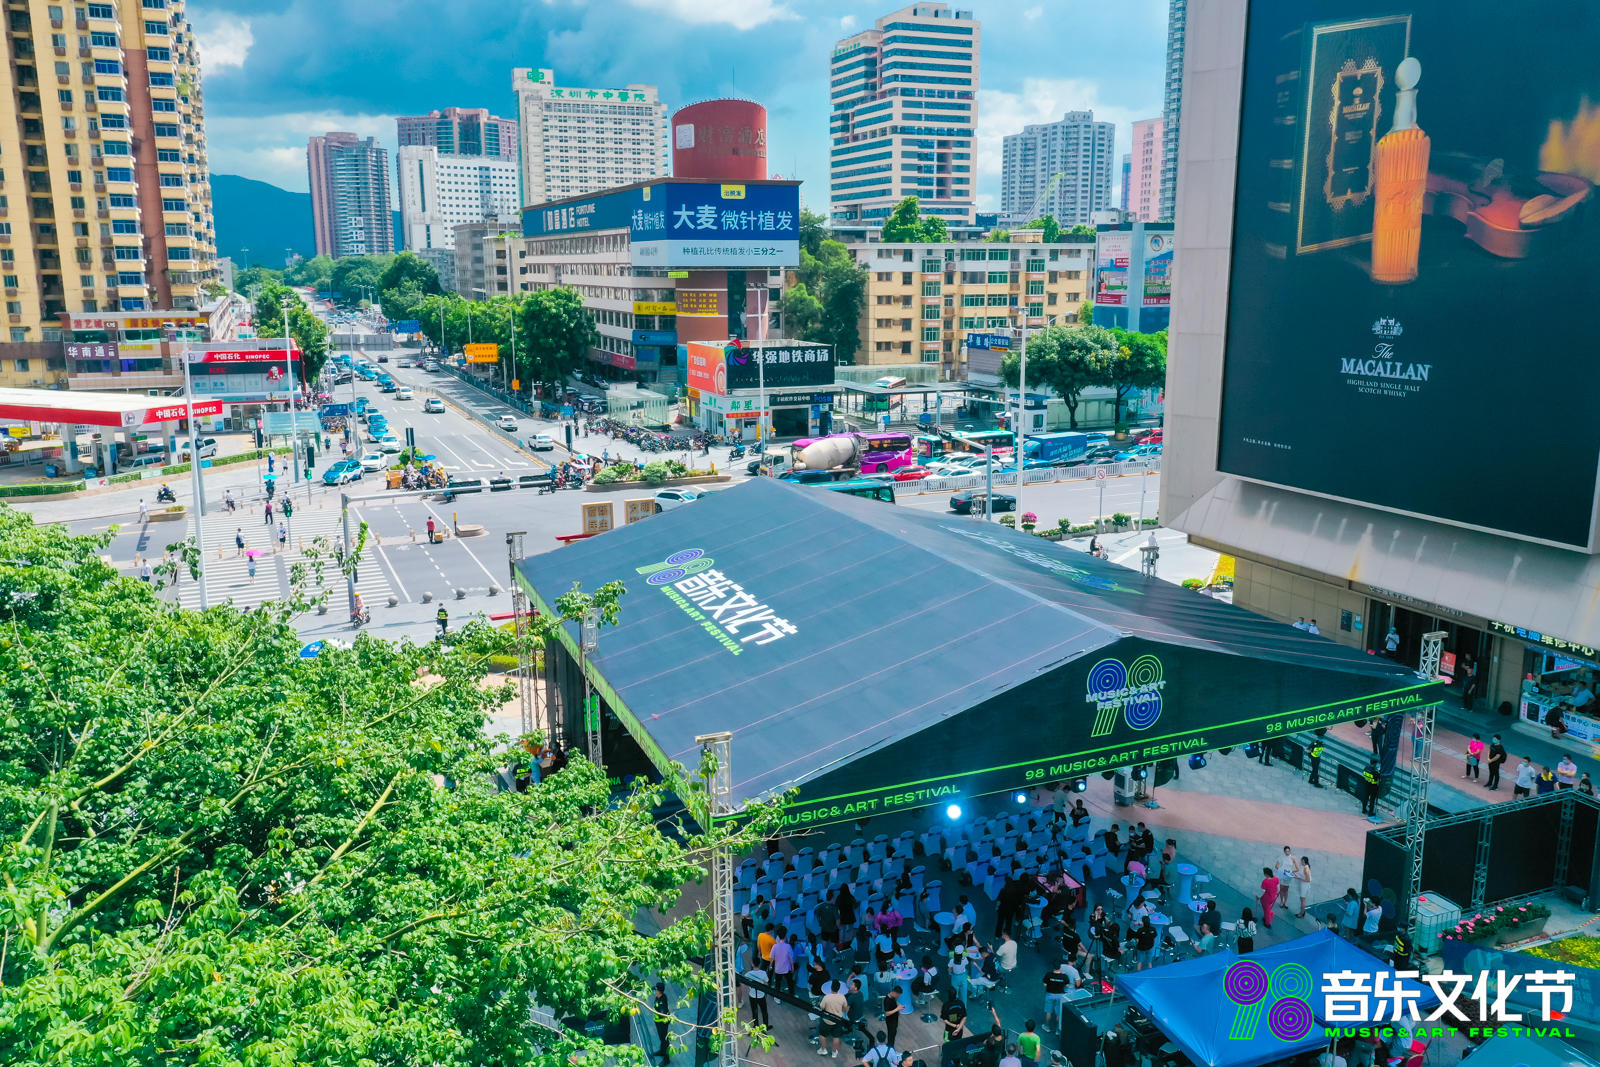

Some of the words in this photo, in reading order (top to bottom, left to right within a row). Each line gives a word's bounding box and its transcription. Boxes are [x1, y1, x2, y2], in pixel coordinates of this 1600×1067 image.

[631, 209, 644, 231] 大麦
[673, 203, 718, 230] 大麦
[720, 209, 793, 231] 微针植发
[67, 345, 105, 358] 华南通
[752, 349, 829, 365] 华强地铁商场
[1372, 342, 1394, 359] The
[1340, 357, 1432, 381] MACALLAN
[1346, 379, 1378, 388] HIGHLAND
[1380, 382, 1401, 390] SINGLE
[1404, 384, 1420, 392] MALT
[1357, 387, 1381, 395] SCOTCH
[1383, 389, 1407, 398] WHISKY
[155, 407, 186, 419] 中国石化
[674, 568, 799, 646] 音乐文化节
[700, 621, 744, 656] FESTIVAL
[1096, 692, 1159, 711] FESTIVAL
[1266, 722, 1283, 734] 98
[1365, 693, 1423, 713] FESTIVAL
[1025, 768, 1045, 781] 98
[1143, 737, 1208, 758] FESTIVAL
[884, 784, 961, 808] FESTIVAL
